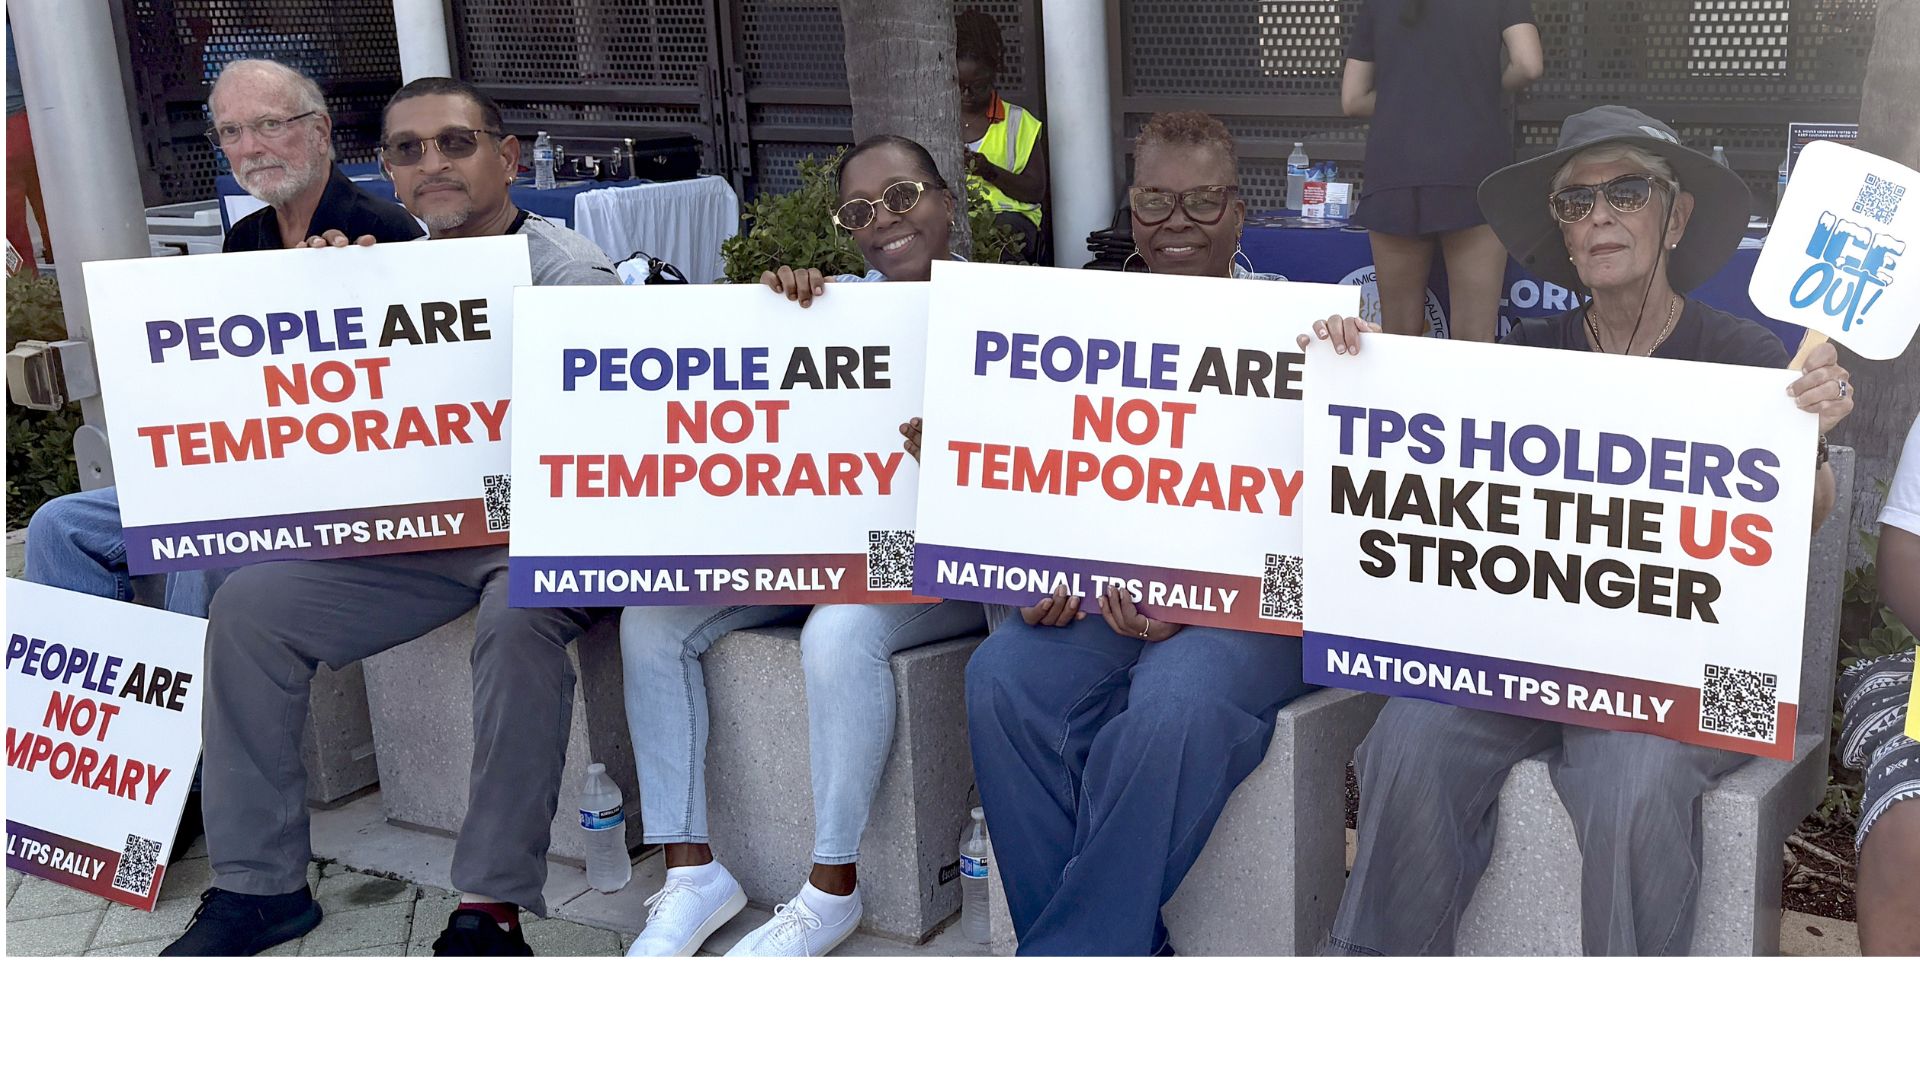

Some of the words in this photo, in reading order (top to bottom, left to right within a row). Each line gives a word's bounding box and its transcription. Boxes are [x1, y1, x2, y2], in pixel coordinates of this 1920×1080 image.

[1806, 211, 1906, 287] ICE
[1790, 262, 1885, 332] OUT!
[146, 308, 366, 363] PEOPLE
[379, 299, 491, 347] ARE
[264, 358, 389, 406] NOT
[563, 348, 768, 391] PEOPLE
[780, 346, 890, 389] ARE
[975, 331, 1179, 390] PEOPLE
[1189, 347, 1305, 400] ARE
[138, 400, 510, 467] TEMPORARY
[668, 401, 789, 443] NOT
[1073, 395, 1196, 448] NOT
[1329, 405, 1445, 464] TPS
[1460, 418, 1779, 502] HOLDERS
[540, 453, 903, 497] TEMPORARY
[949, 441, 1303, 516] TEMPORARY
[152, 527, 311, 559] NATIONAL
[314, 522, 370, 545] TPS
[376, 513, 464, 540] RALLY
[1331, 466, 1520, 535] MAKE
[1534, 488, 1663, 553] THE
[1680, 507, 1772, 566] US
[535, 570, 689, 592] NATIONAL
[695, 569, 749, 591] TPS
[756, 568, 845, 590] RALLY
[937, 560, 1085, 597] NATIONAL
[1149, 581, 1238, 613] RALLY
[1360, 530, 1721, 624] STRONGER
[6, 634, 123, 695] PEOPLE
[119, 663, 192, 711] ARE
[1328, 649, 1492, 696] NATIONAL
[1499, 674, 1560, 705] TPS
[1568, 684, 1674, 722] RALLY
[43, 691, 120, 741] NOT
[6, 728, 171, 805] MPORARY
[20, 838, 50, 864] TPS
[50, 848, 105, 880] RALLY
